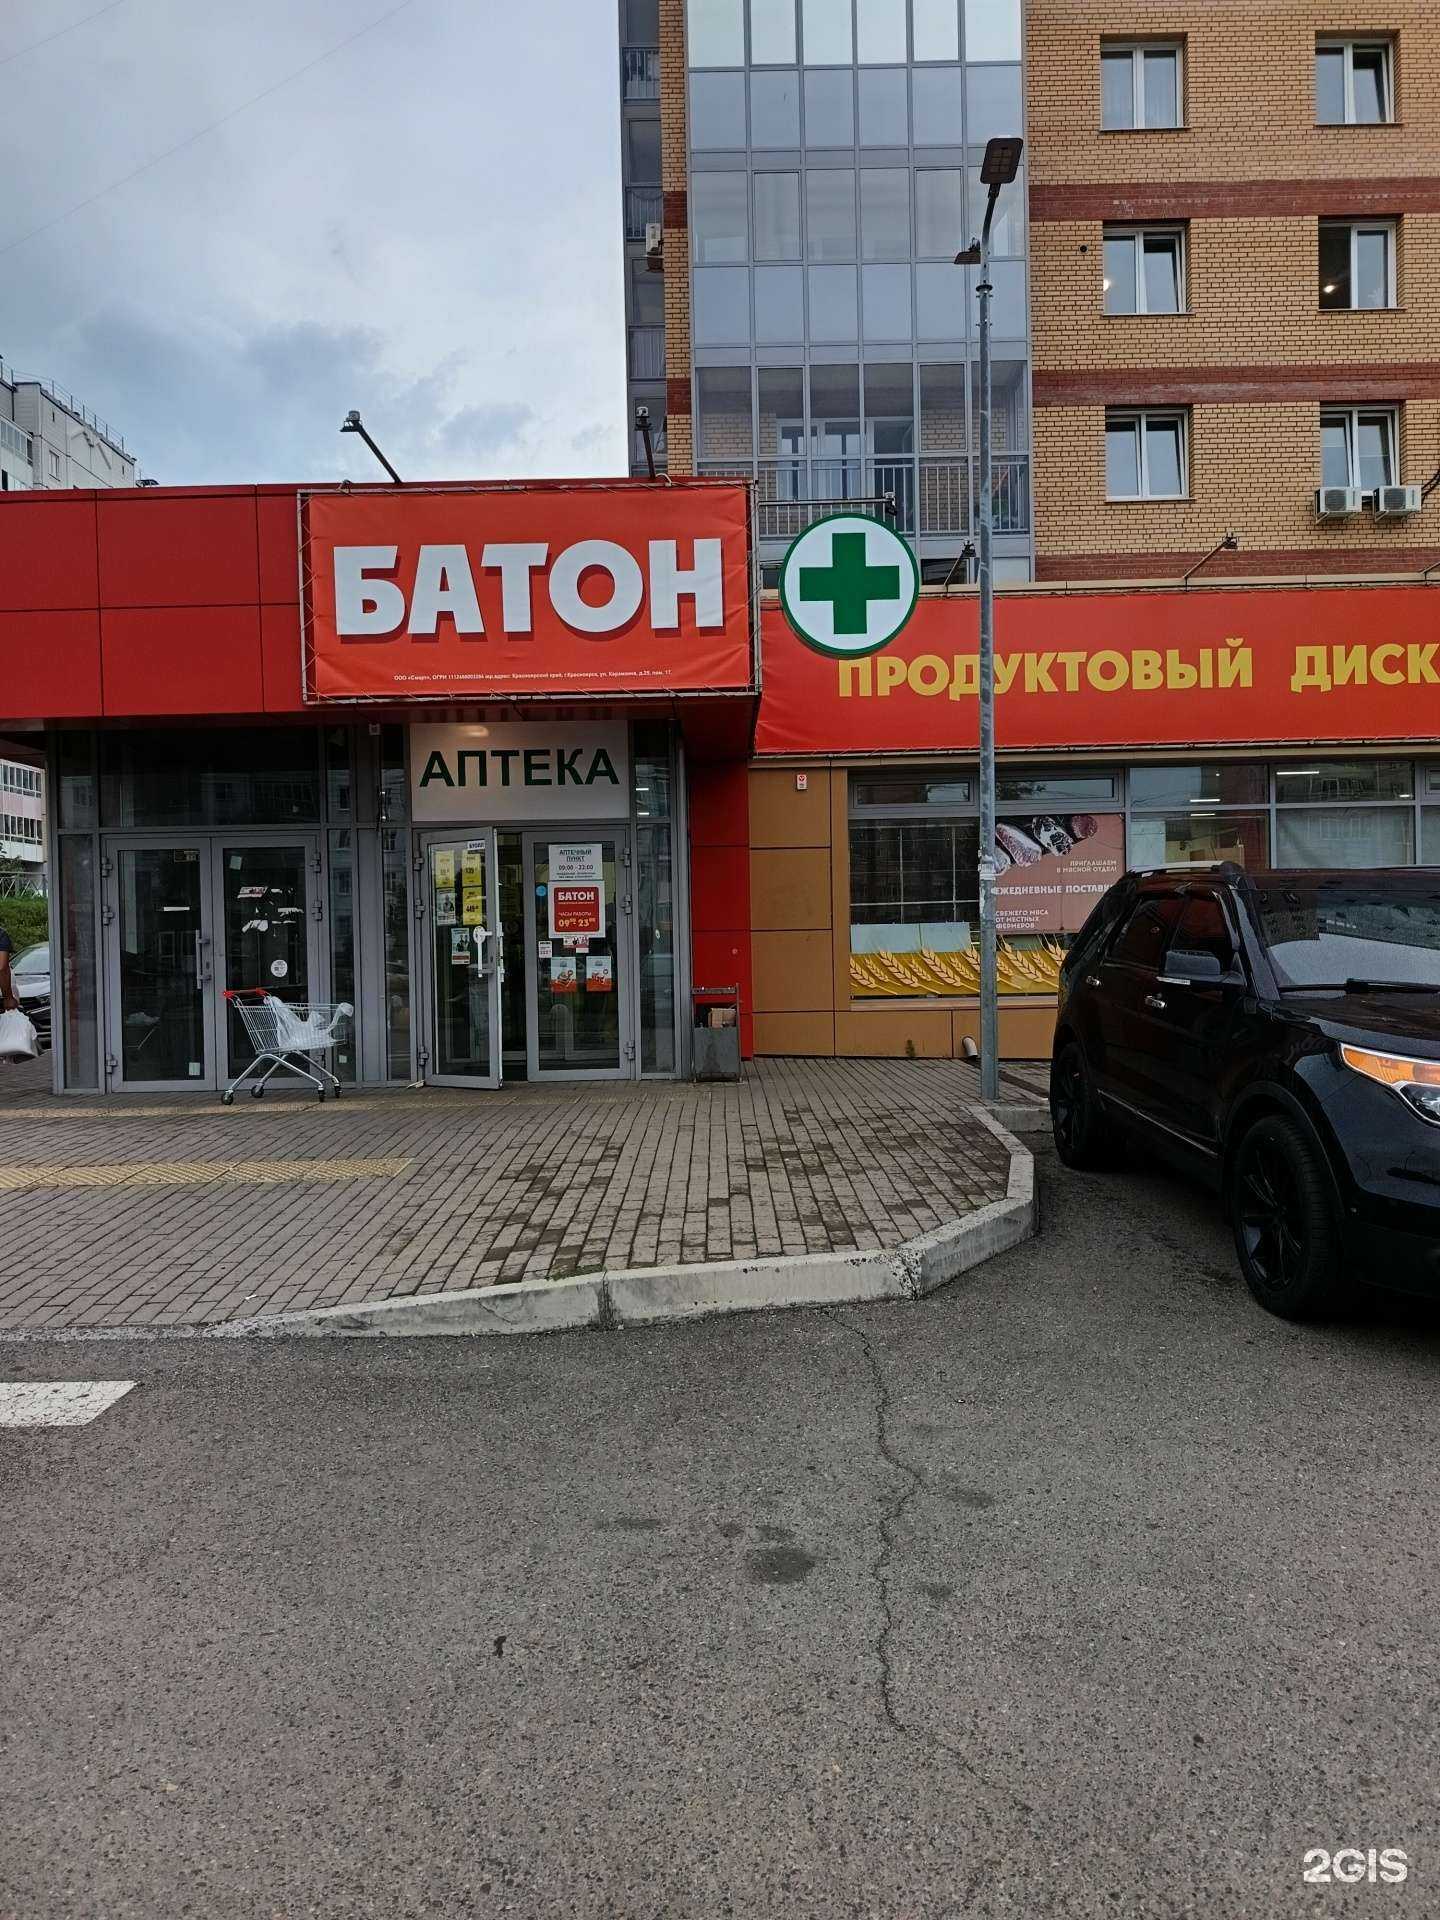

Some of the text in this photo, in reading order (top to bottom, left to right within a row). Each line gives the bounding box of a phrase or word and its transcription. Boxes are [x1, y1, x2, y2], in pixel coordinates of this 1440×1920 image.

[333, 538, 725, 636] БАТОН
[838, 638, 1440, 701] ПРОДУКТОВЫЙ ДИСК
[419, 748, 620, 788] АПТЕКА
[566, 855, 585, 863] ПУНКТ
[557, 891, 595, 901] БАТОН
[994, 884, 1115, 895] ЕЖЕДНЕВНЫЕ ПОСТАВК
